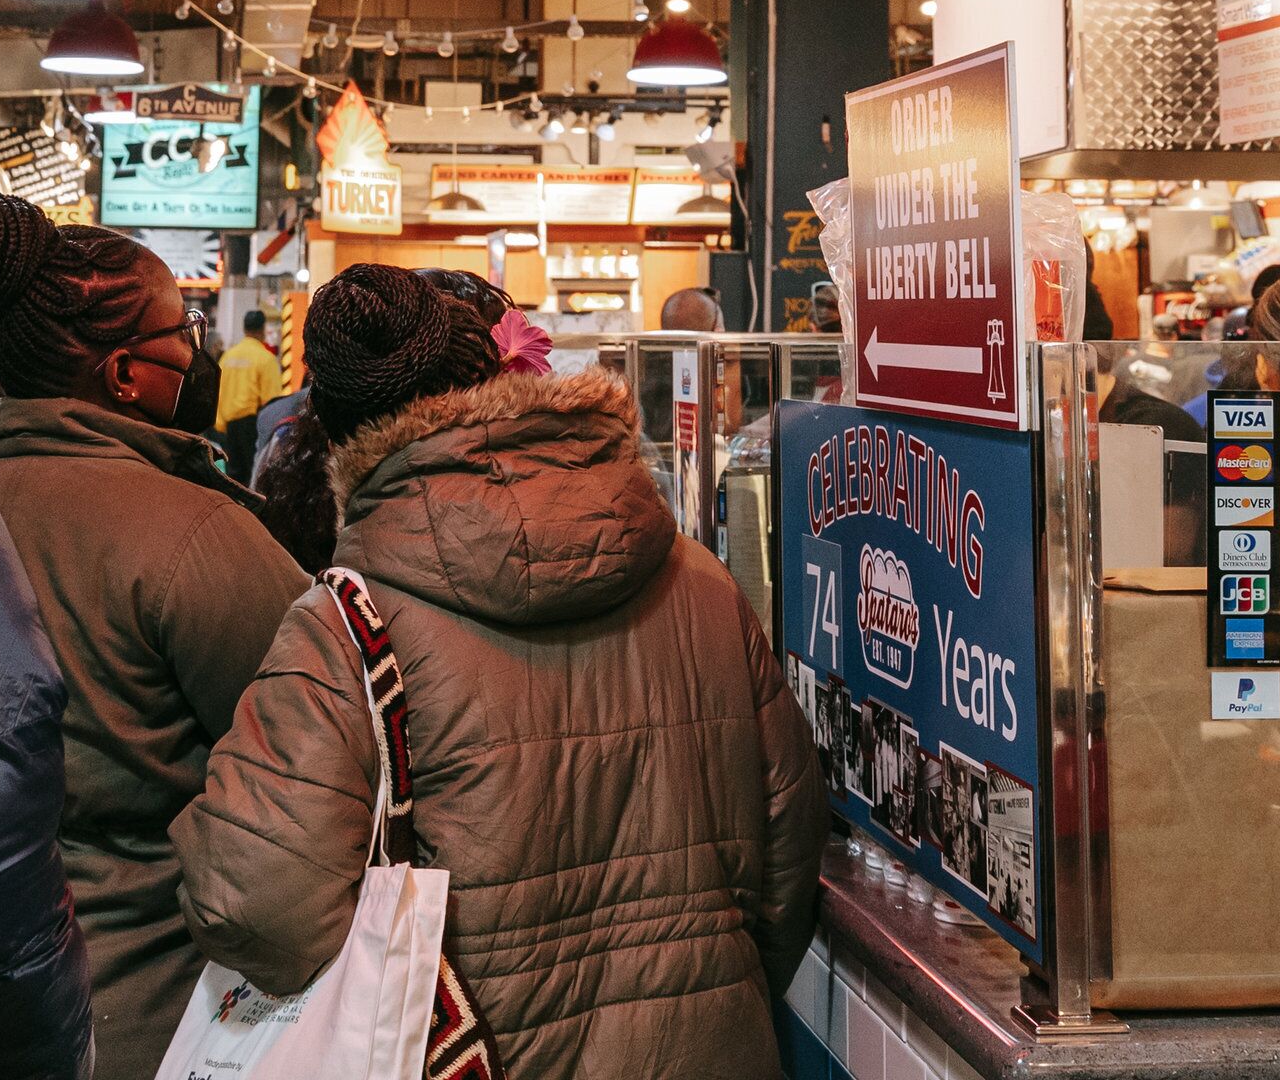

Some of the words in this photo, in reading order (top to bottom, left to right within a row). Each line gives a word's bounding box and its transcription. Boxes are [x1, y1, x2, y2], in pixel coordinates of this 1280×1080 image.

[183, 85, 197, 101] C
[172, 100, 241, 117] AVENUE
[890, 84, 953, 156] ORDER
[542, 170, 630, 183] ANDWICHES
[326, 180, 397, 217] TURKEY
[873, 167, 936, 231] UNDER
[940, 157, 980, 222] THE
[866, 240, 938, 301] LIBERTY
[945, 236, 997, 299] BELL
[1222, 410, 1267, 427] VISA
[1217, 457, 1271, 470] MasterCard
[1217, 498, 1271, 509] DISCOVER
[807, 424, 986, 600] CELEBRATING
[1223, 552, 1245, 562] Diners
[1247, 552, 1268, 562] Club
[1223, 587, 1267, 601] JCB
[856, 560, 921, 646] Spataro's
[1226, 632, 1264, 641] AMERICAN
[1233, 640, 1265, 648] EXPRESS
[806, 562, 840, 670] 74
[933, 603, 1018, 743] Years
[1228, 703, 1263, 713] PayPal
